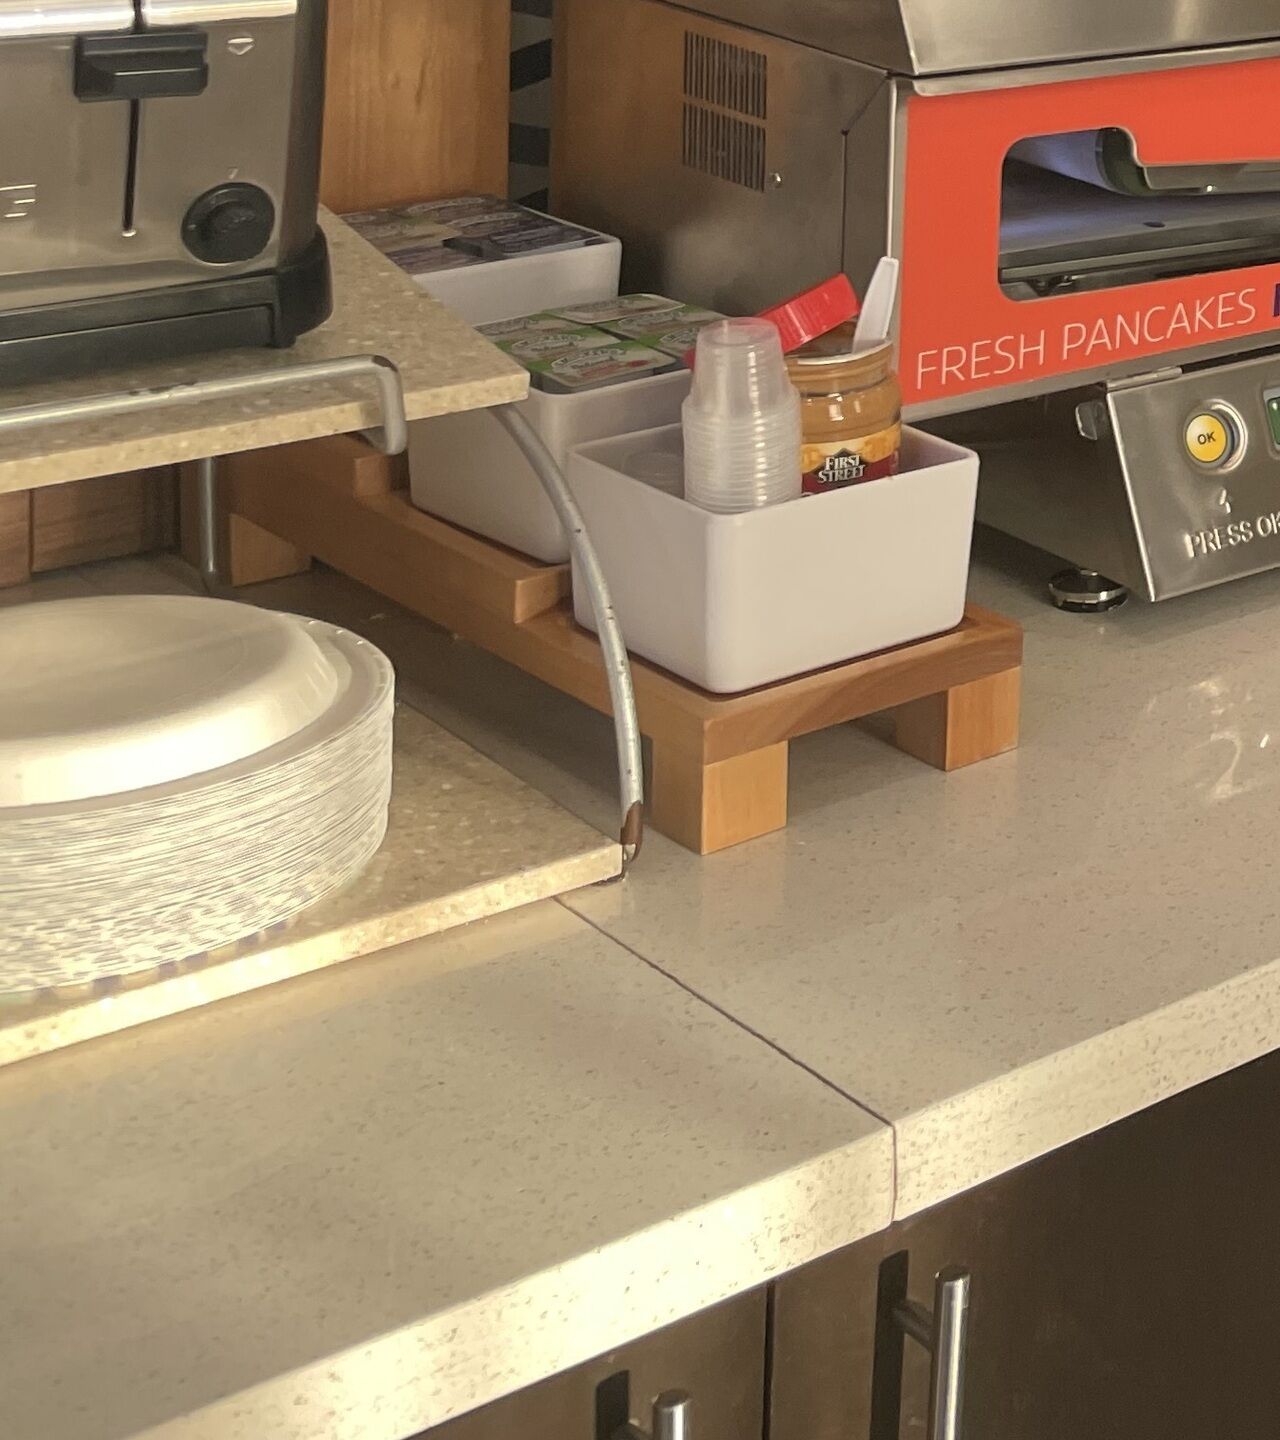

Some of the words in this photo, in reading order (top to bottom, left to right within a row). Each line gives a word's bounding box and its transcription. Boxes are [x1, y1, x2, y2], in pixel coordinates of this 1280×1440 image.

[915, 328, 1044, 390] FRESH
[1062, 288, 1256, 361] PANCAKES
[1197, 431, 1217, 446] OK
[825, 453, 861, 472] FIRST
[818, 465, 866, 483] STREET
[1183, 521, 1255, 559] PRESS
